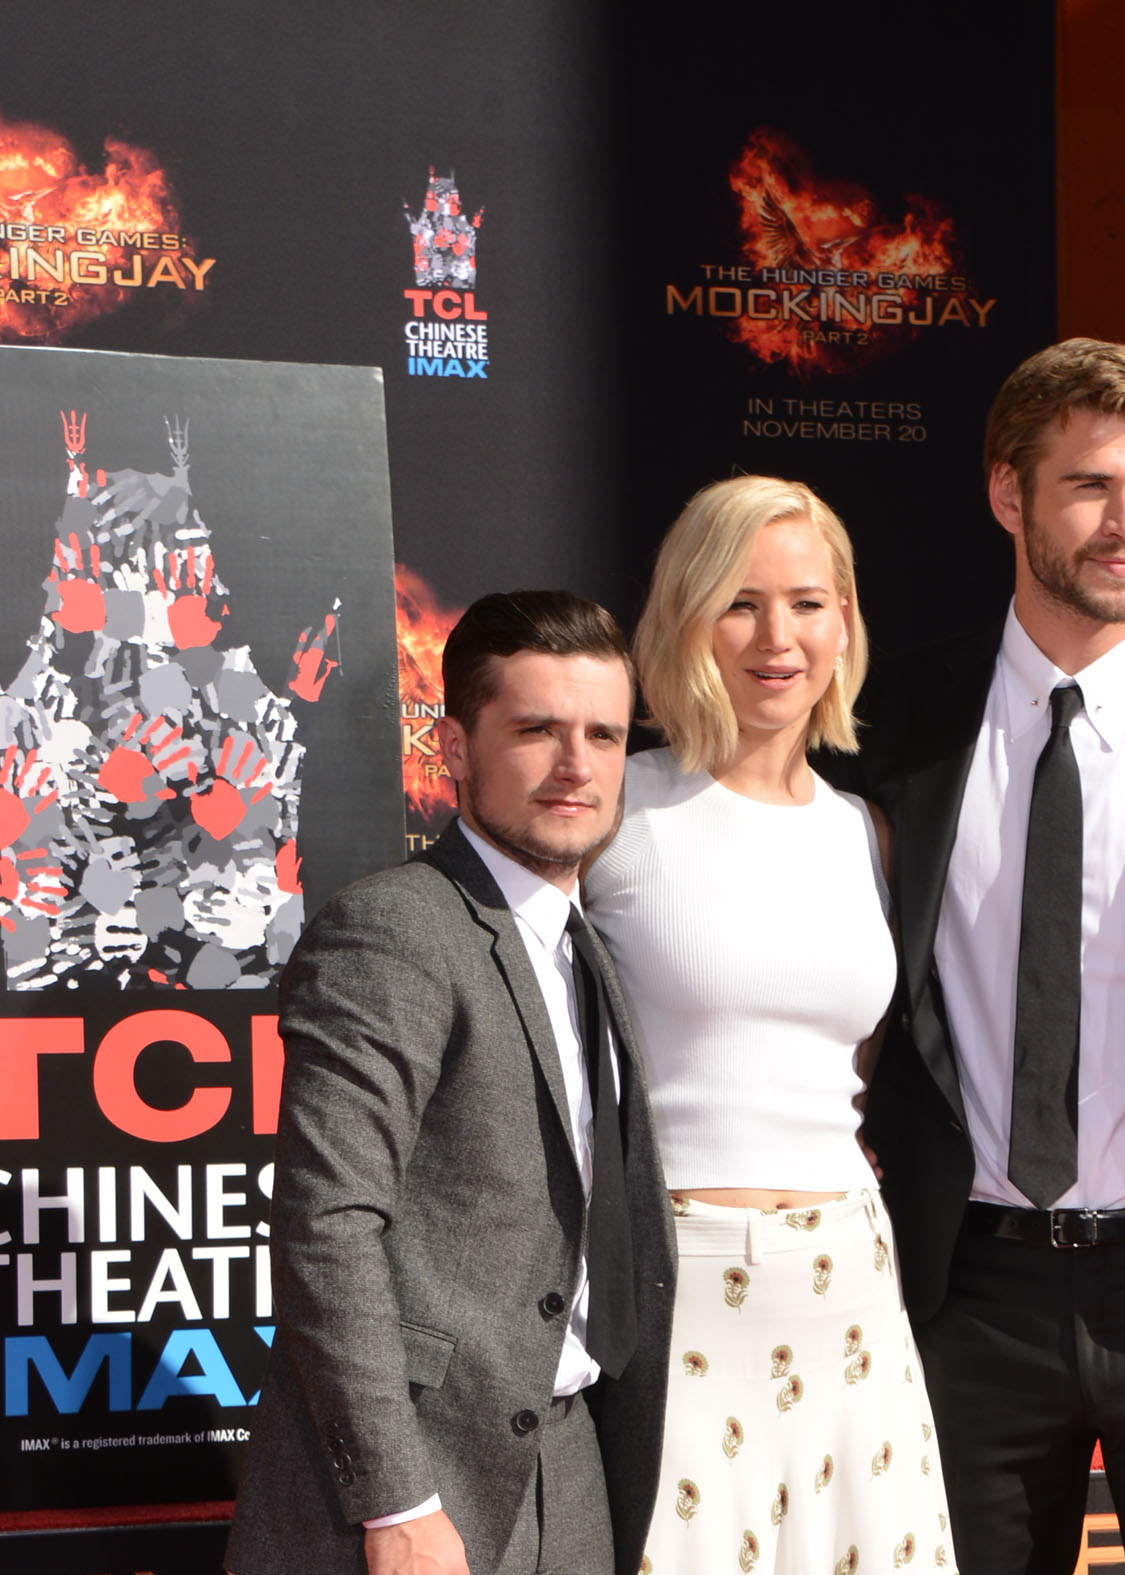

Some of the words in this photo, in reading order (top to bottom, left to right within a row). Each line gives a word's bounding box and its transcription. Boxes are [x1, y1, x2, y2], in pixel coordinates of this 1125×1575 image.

[0, 223, 66, 243] GER
[76, 228, 188, 250] GAMES:
[0, 247, 217, 291] INGJAY
[700, 264, 752, 282] THE
[762, 267, 868, 288] HUNGER
[877, 271, 974, 292] GAMES:
[0, 288, 50, 305] ART
[54, 290, 69, 306] 2
[403, 288, 488, 321] TCL
[665, 283, 998, 328] MOCKINGJAY
[404, 321, 489, 343] CHINESE
[801, 329, 852, 345] PART
[856, 333, 869, 346] 2
[405, 339, 489, 360] THEATRE
[407, 356, 489, 379] IMAX
[748, 398, 773, 415] IN
[784, 399, 922, 421] THEATERS
[743, 420, 890, 441] NOVEMBER
[899, 424, 927, 443] 20
[0, 1162, 275, 1246] HINE
[0, 1246, 274, 1326] HEAT
[60, 1437, 71, 1450] is
[72, 1439, 80, 1449] a
[82, 1436, 136, 1450] registered
[138, 1431, 192, 1447] trademark
[193, 1430, 205, 1443] of
[207, 1428, 235, 1443] IMAX
